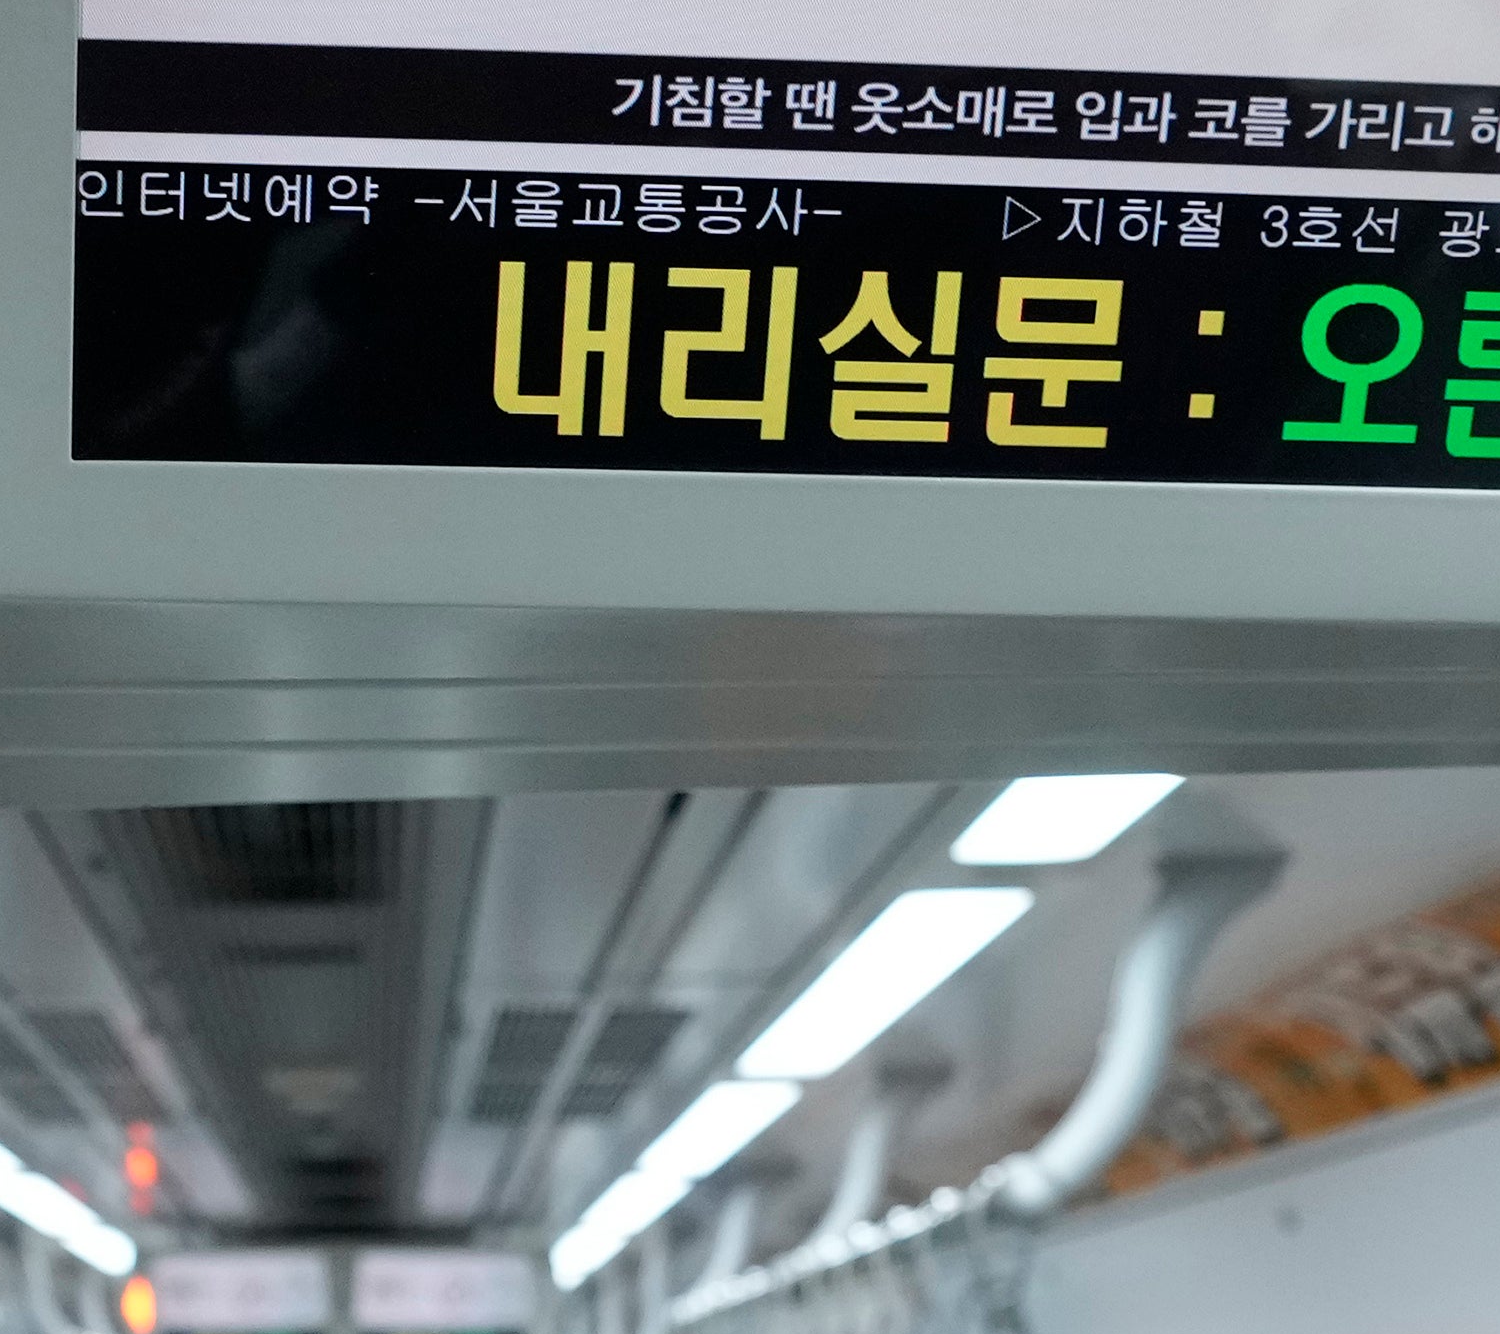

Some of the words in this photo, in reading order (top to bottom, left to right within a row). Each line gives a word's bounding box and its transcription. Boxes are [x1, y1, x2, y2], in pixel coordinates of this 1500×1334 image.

[611, 74, 771, 130] 기침할
[785, 79, 837, 131] 땐
[851, 82, 1057, 137] 옷소매로
[1076, 90, 1177, 144] 입과
[1187, 96, 1292, 148] 코를
[1304, 98, 1455, 152] 가리고
[78, 169, 380, 225] 인터넷예약
[414, 178, 842, 237] -서울교통공사-
[1057, 196, 1223, 249] 지하철
[1260, 204, 1401, 254] 3호선
[493, 260, 1125, 448] 내리실문
